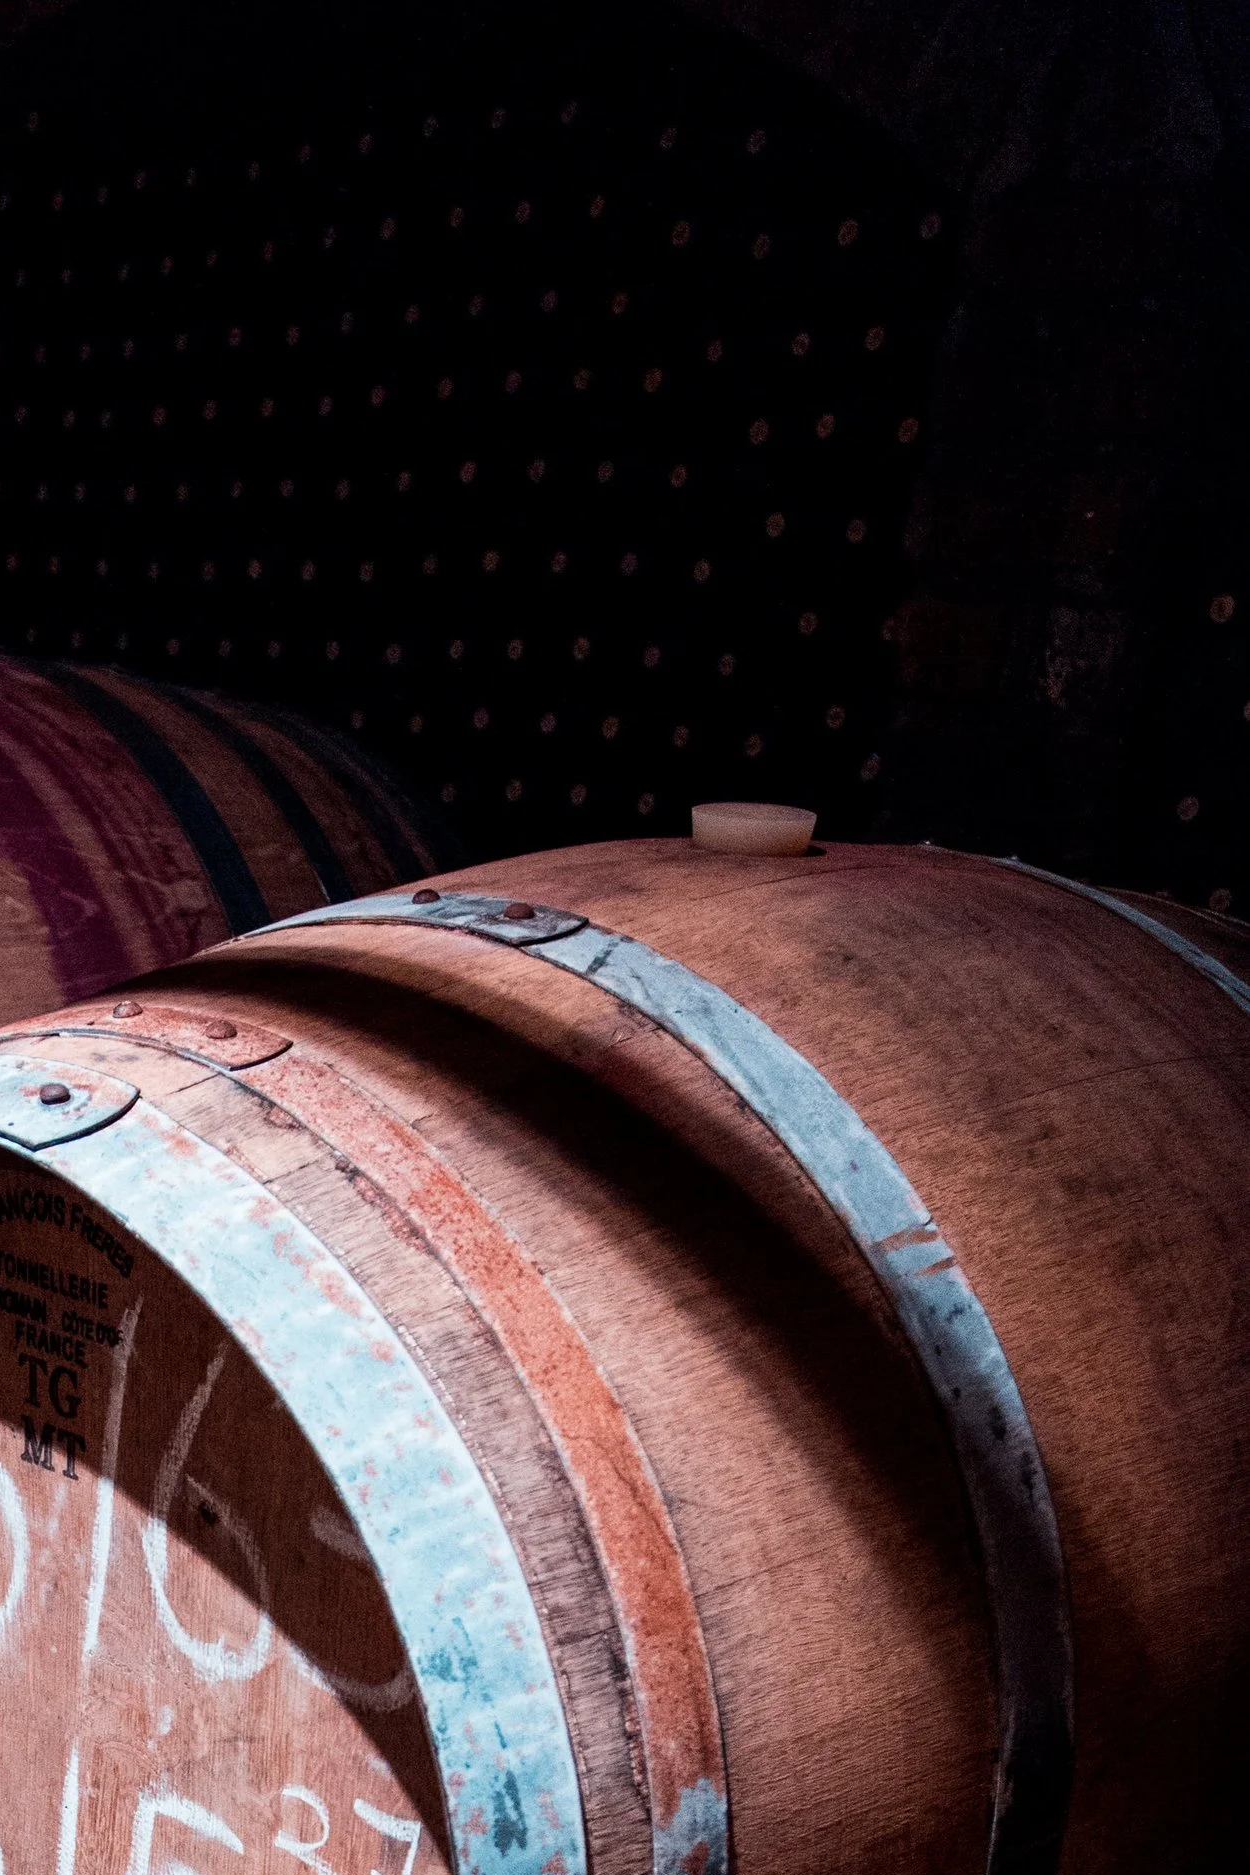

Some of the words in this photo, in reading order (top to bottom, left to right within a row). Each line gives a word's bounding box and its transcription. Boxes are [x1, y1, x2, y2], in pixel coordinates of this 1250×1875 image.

[14, 1319, 89, 1369] FRANCE
[18, 1352, 83, 1419] TG
[20, 1414, 87, 1482] MT
